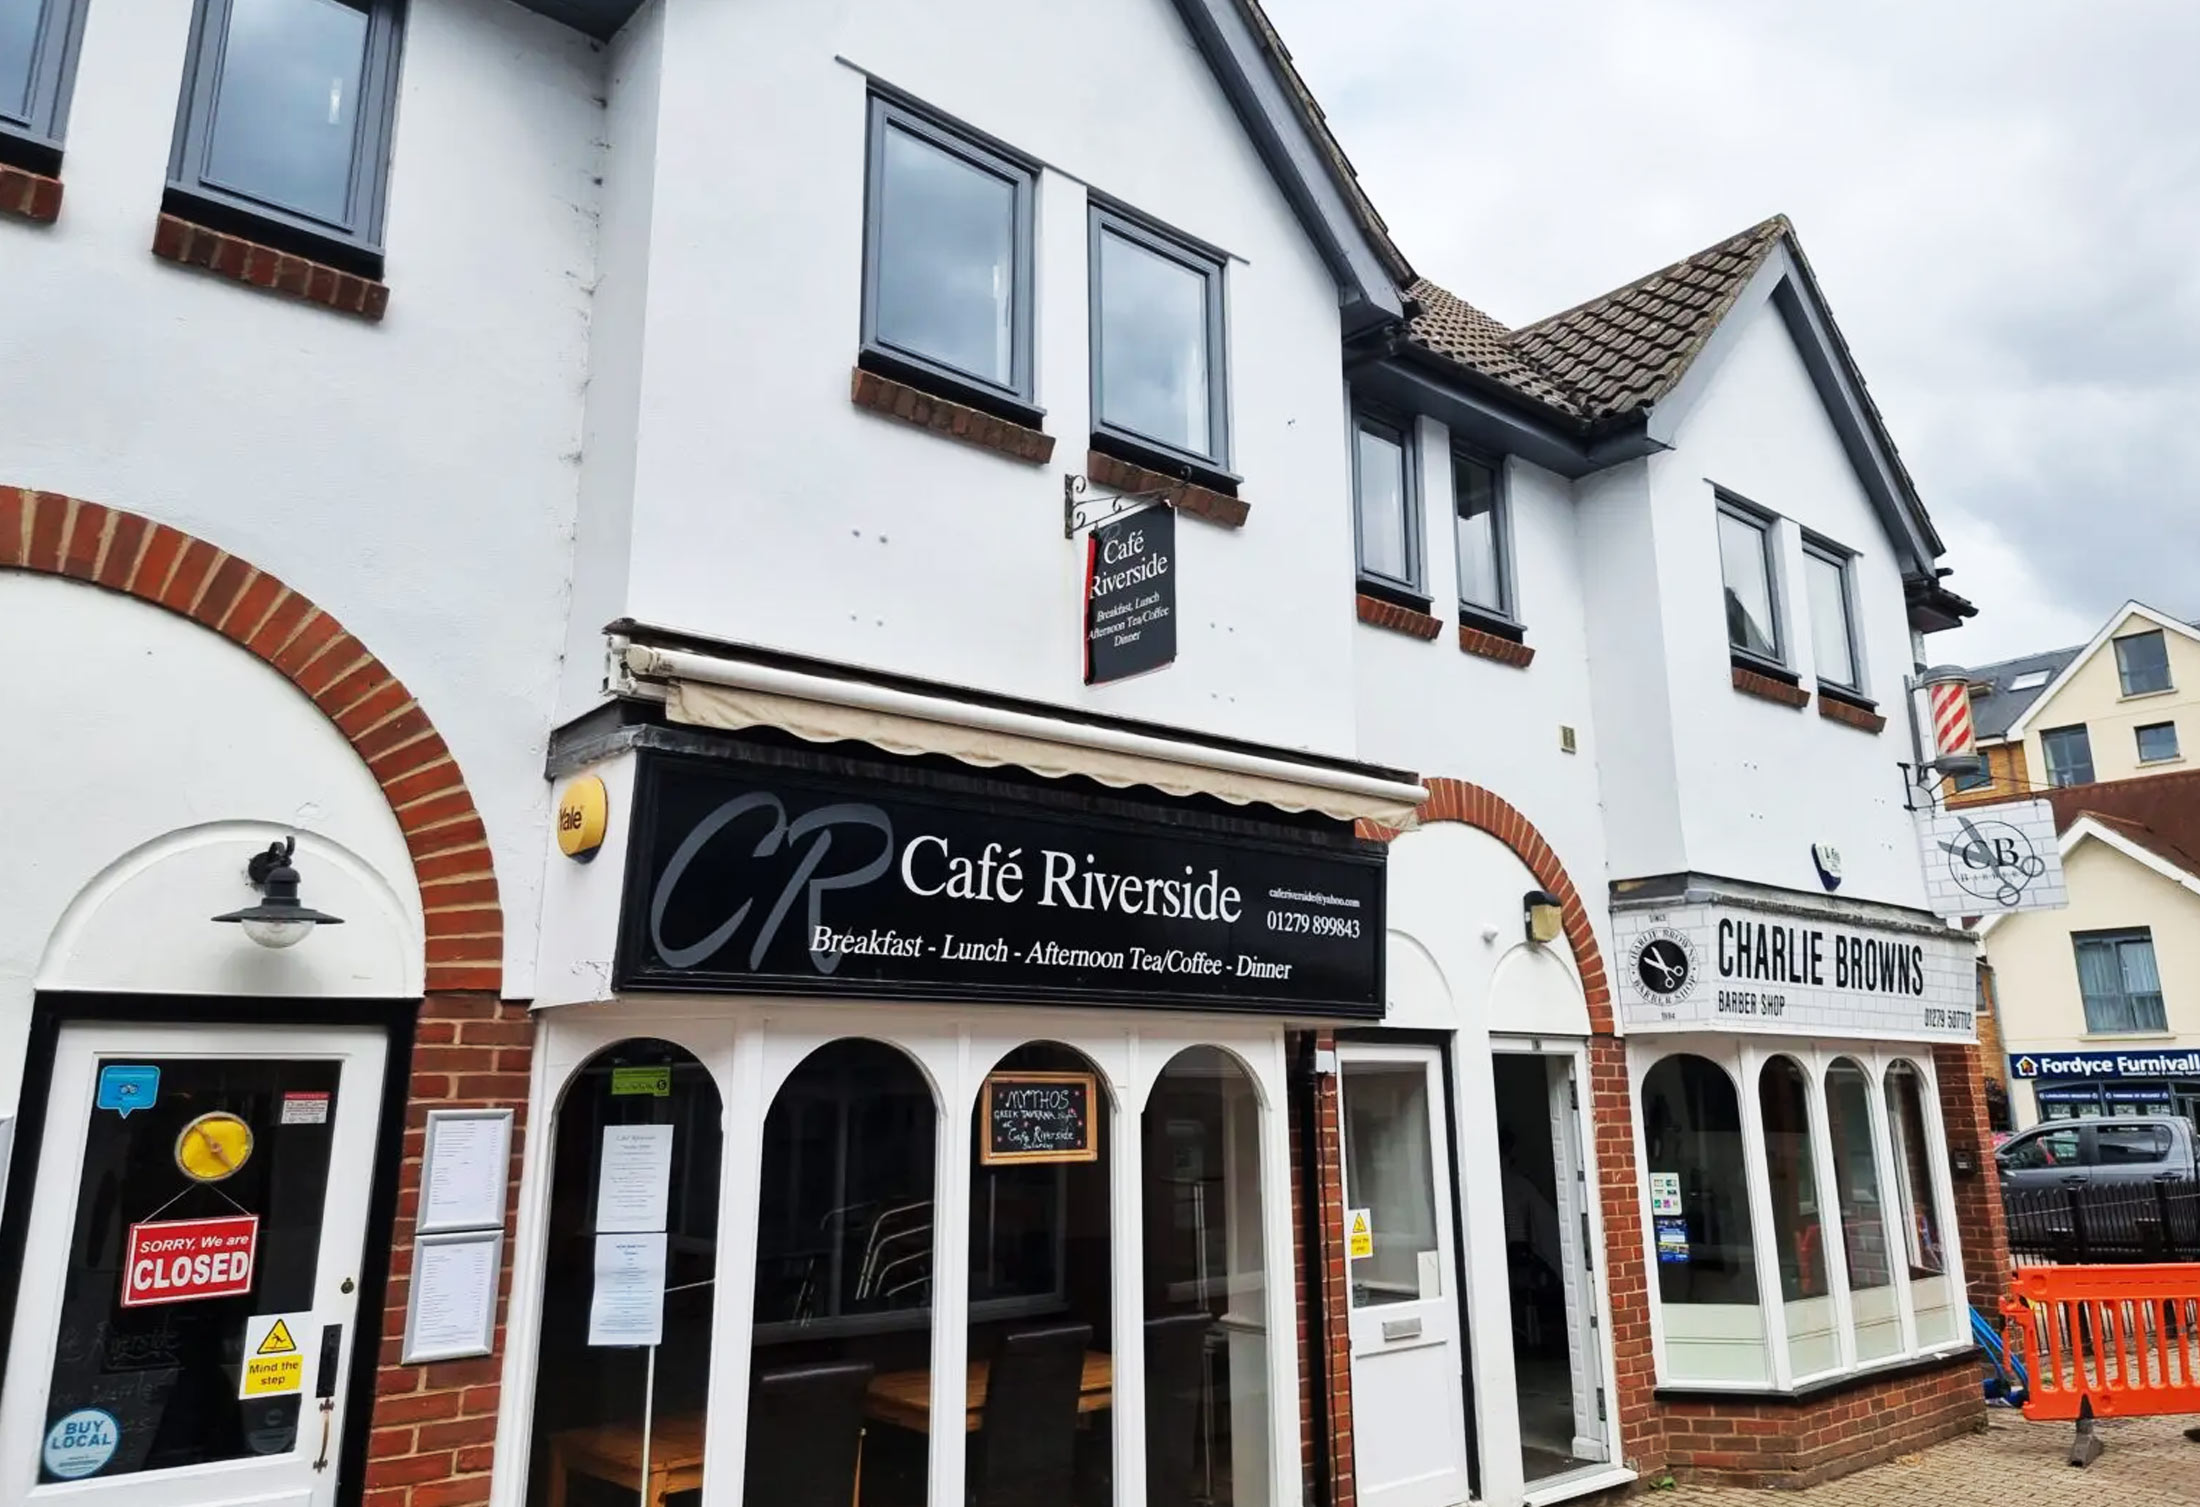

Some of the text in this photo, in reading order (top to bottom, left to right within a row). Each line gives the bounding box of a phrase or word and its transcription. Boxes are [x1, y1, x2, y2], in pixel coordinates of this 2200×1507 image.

[1103, 529, 1145, 564] Café
[1089, 552, 1169, 599] Riverside
[1135, 591, 1160, 609] Lunch
[1088, 621, 1125, 640] Afternoon
[1113, 630, 1142, 647] Dinner
[559, 805, 583, 831] Yale
[901, 835, 1243, 924] Café Riverside
[1266, 910, 1360, 939] 01279 899843
[809, 924, 924, 957] Breakfast
[941, 933, 1009, 962] Lunch
[1025, 940, 1124, 970] Afternoon
[1129, 946, 1223, 975] Tea/Coffee
[1235, 954, 1293, 980] Dinner
[1718, 918, 1924, 997] CHARLIE BROWNS
[1718, 990, 1786, 1016] BARBER SHOP
[2041, 1053, 2200, 1076] Fordyce Furnivall
[1005, 1089, 1070, 1110] MYTHOS
[140, 1235, 250, 1254] SORRY, We are
[133, 1250, 250, 1291] CLOSED
[249, 1360, 300, 1375] Mind the
[260, 1375, 286, 1386] step
[65, 1420, 105, 1435] BUY
[51, 1433, 112, 1449] LOCAL
